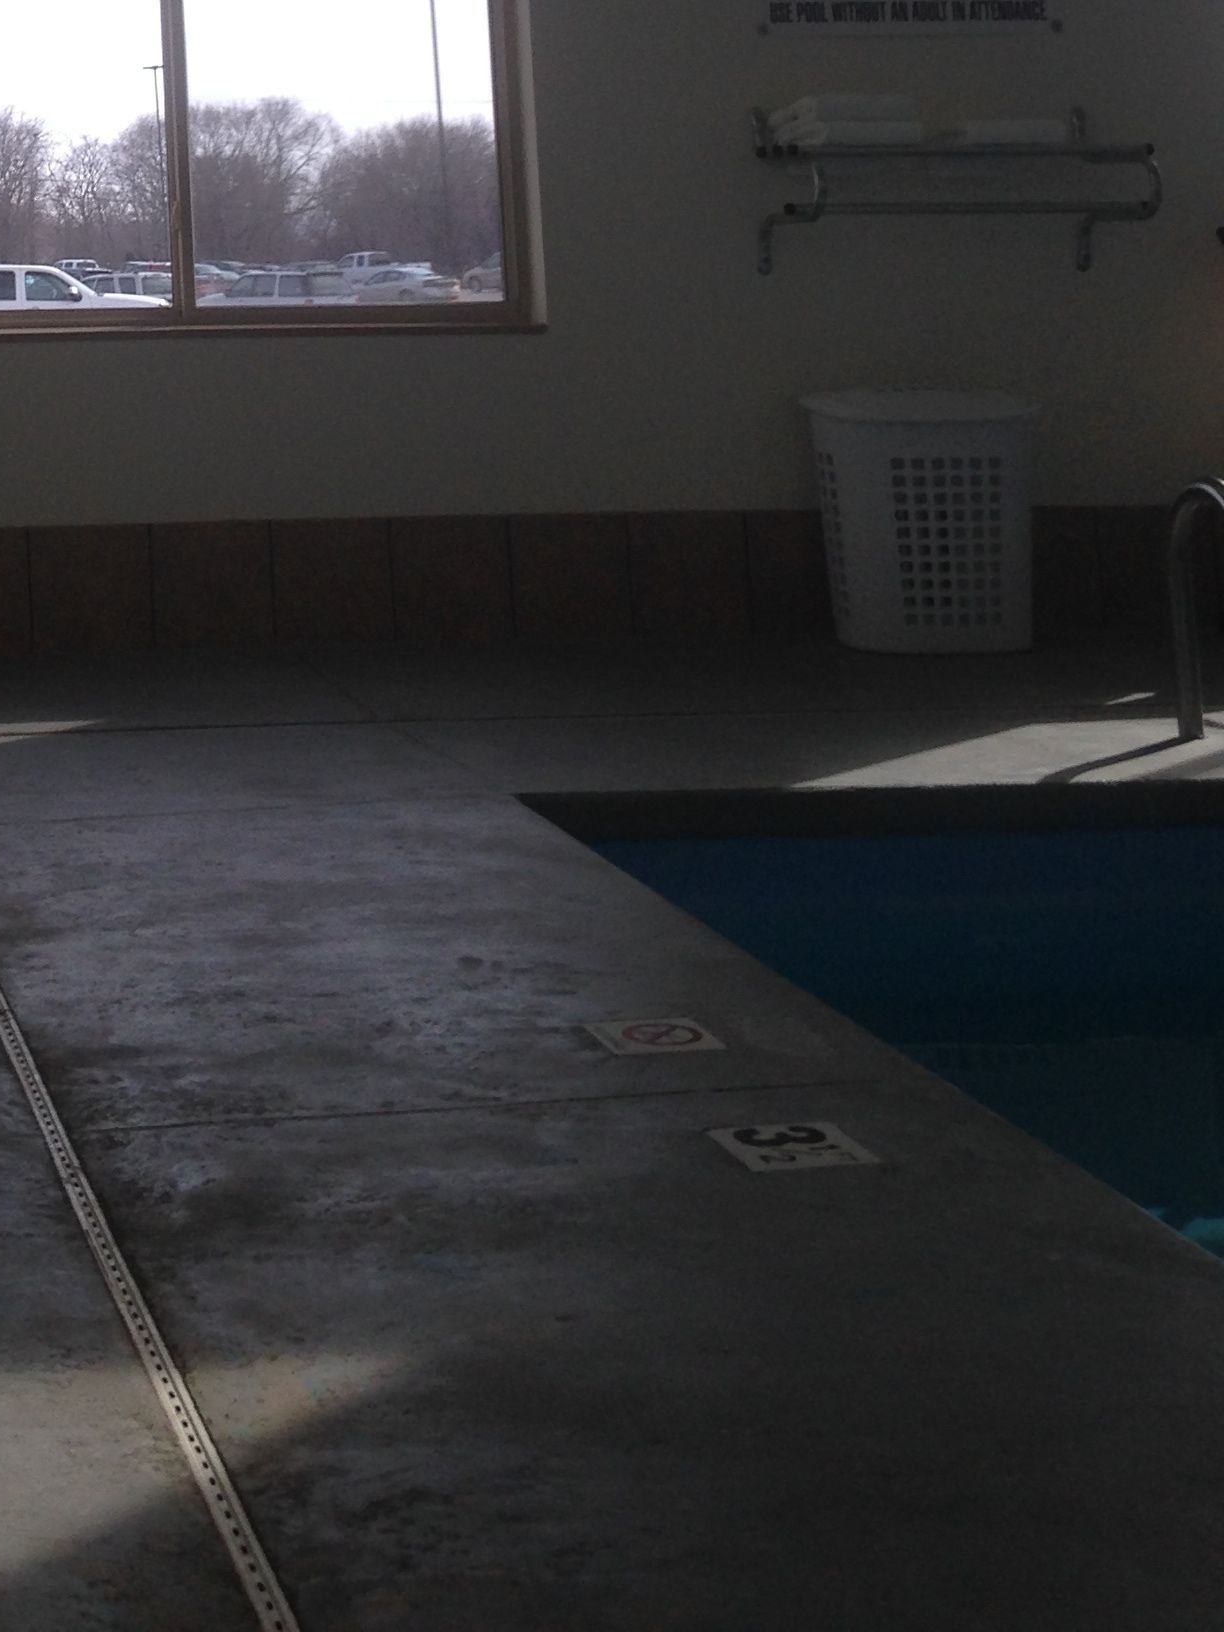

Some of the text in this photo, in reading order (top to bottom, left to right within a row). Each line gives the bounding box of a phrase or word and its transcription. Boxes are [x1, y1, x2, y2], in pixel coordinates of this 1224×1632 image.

[769, 1, 793, 24] USE
[796, 1, 829, 24] POOL
[831, 1, 886, 23] WITHOUT
[891, 0, 909, 22] AN
[912, 0, 947, 21] ADULT
[951, 0, 965, 21] IN
